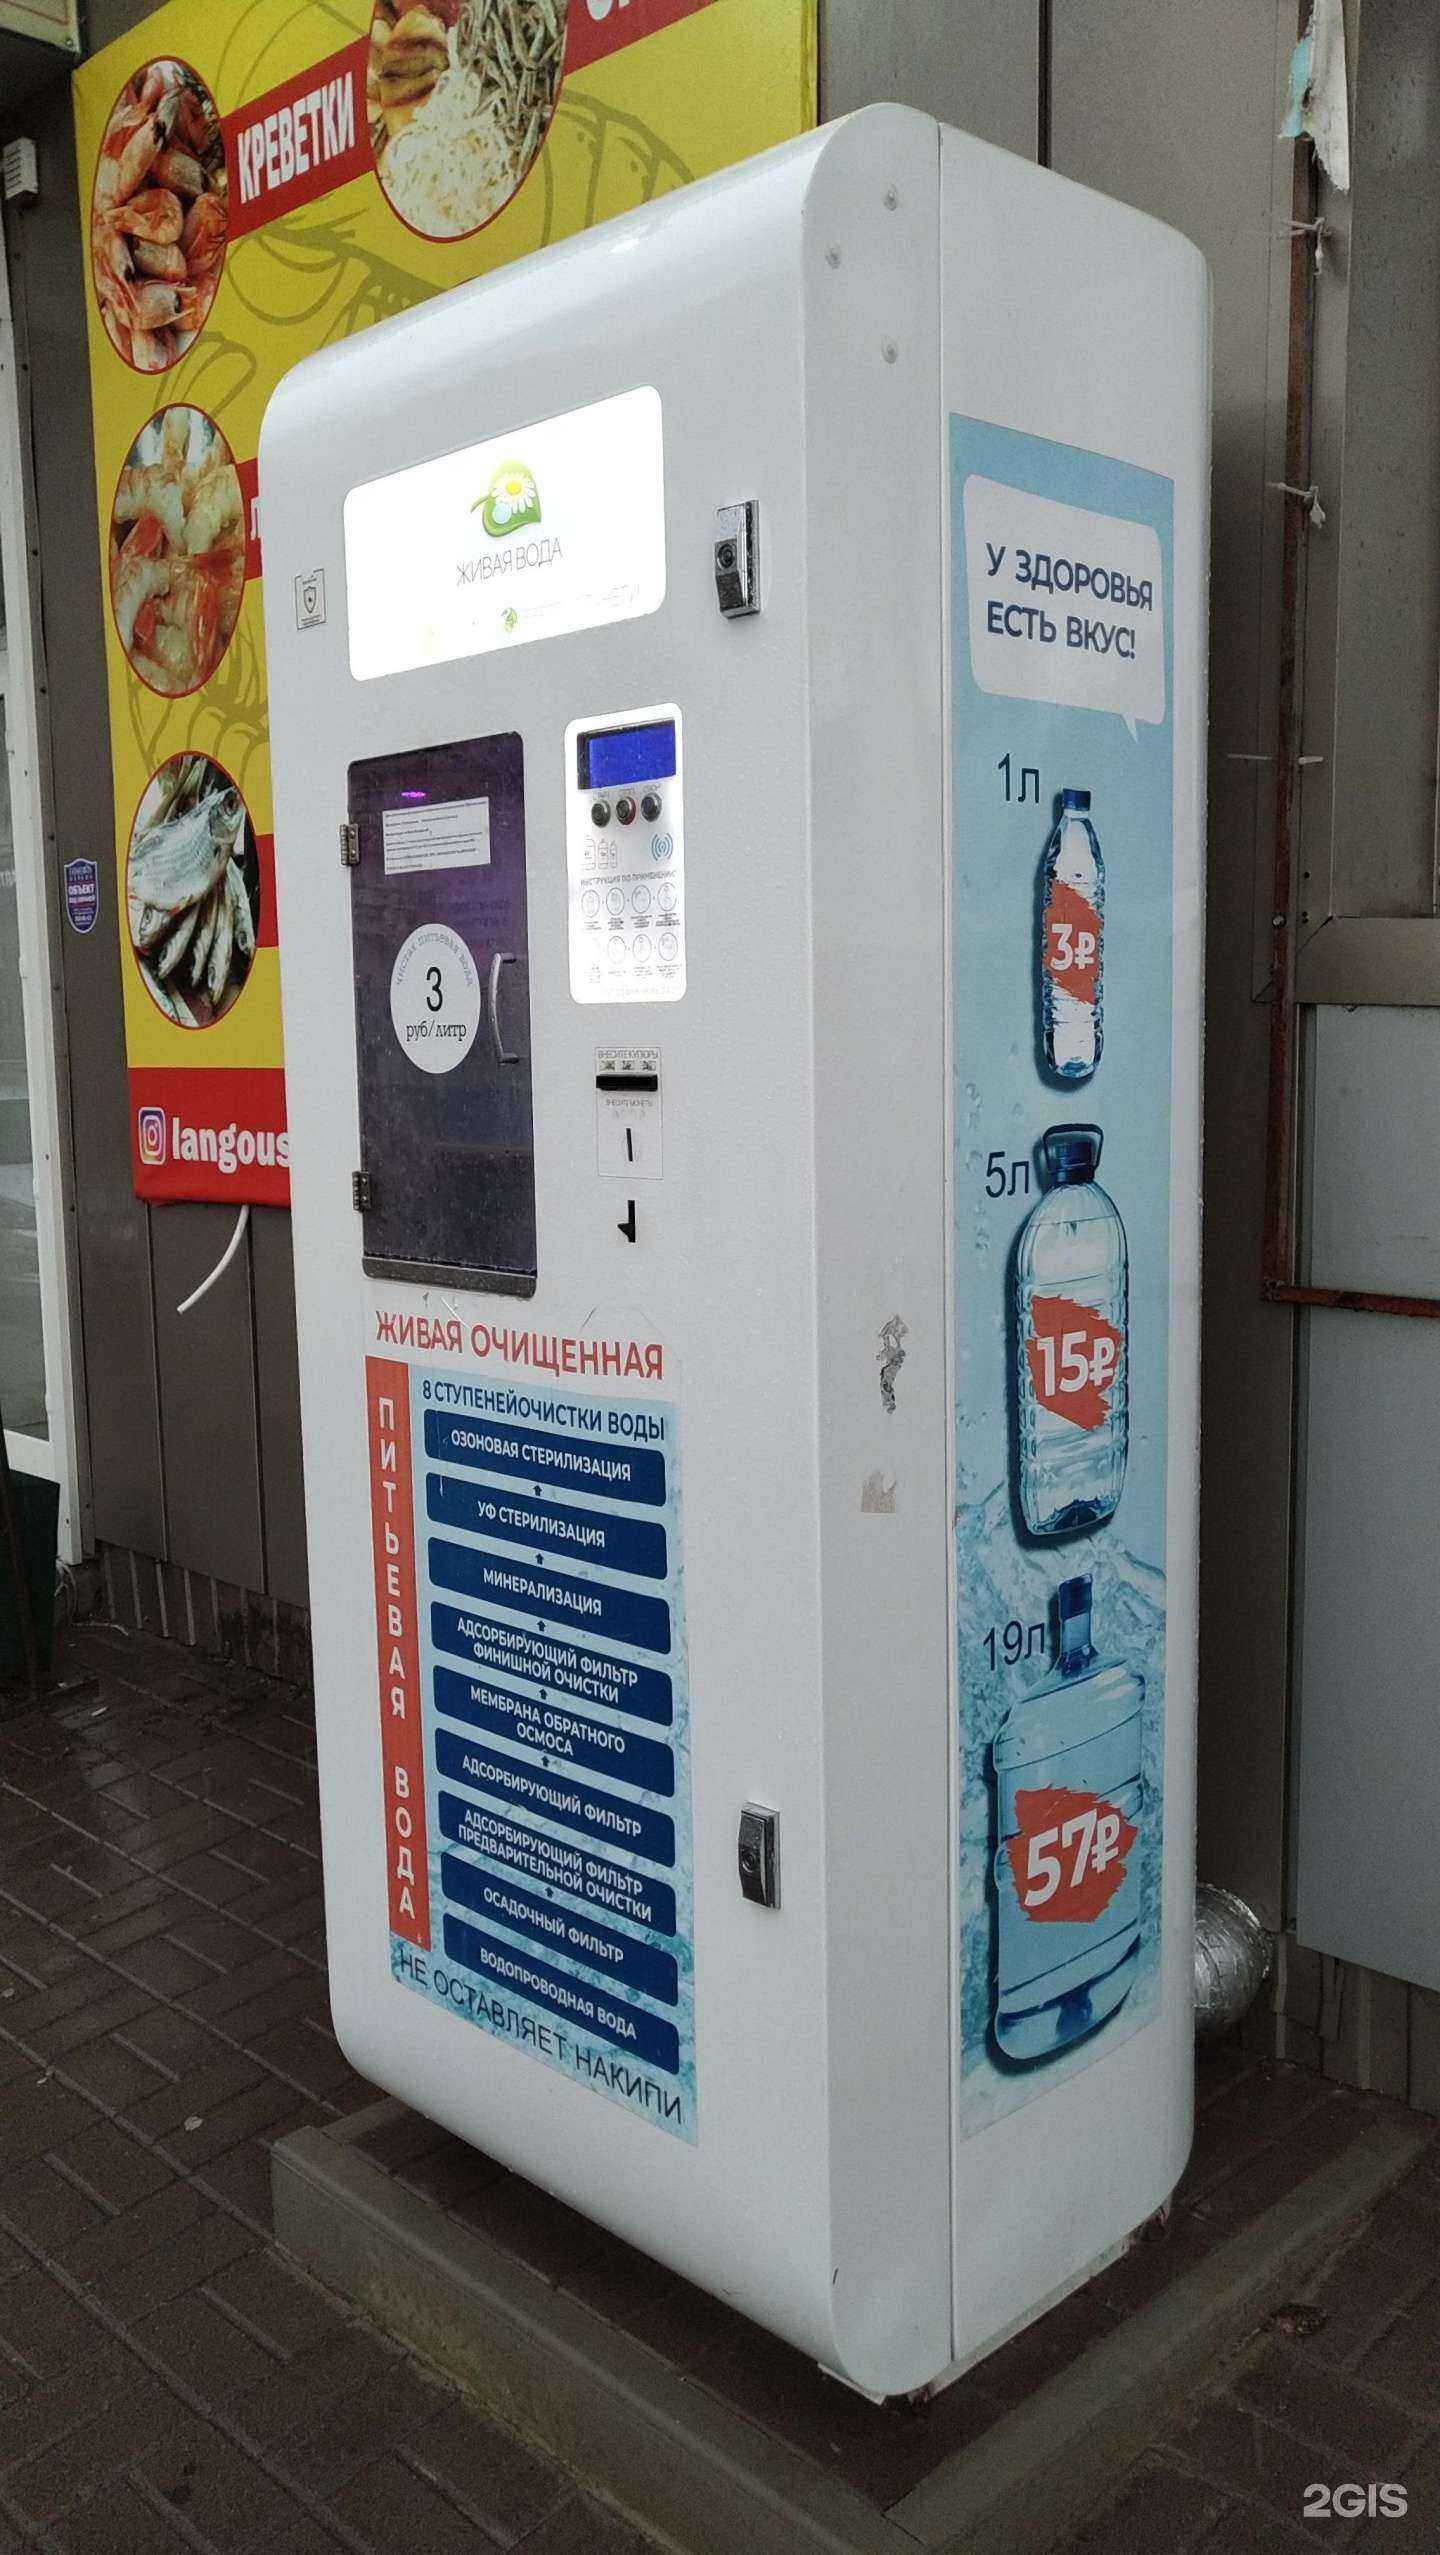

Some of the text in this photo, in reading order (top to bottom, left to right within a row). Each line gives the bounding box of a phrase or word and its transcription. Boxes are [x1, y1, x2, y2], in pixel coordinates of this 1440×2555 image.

[237, 71, 355, 204] КРЕВЕТКИ
[456, 537, 563, 586] ЖИВАЯ ВОДА
[986, 542, 1153, 611] У ЗДОРОВЬЯ
[987, 600, 1136, 660] ЕСТЬ ВКУС!
[998, 752, 1040, 804] 1л
[426, 967, 443, 1011] 3
[406, 1020, 467, 1042] руб/литр
[985, 1151, 1030, 1199] 5л
[376, 1310, 663, 1381] ЖИВАЯ ОЧИЩЕННАЯ
[422, 1380, 432, 1400] 8
[608, 1412, 664, 1442] ВОДЫ
[451, 1429, 631, 1482] ОЗОНОВАЯ СТЕРИЛИЗАЦИЯ
[477, 1500, 605, 1548] УФ СТЕРИЛИЗАЦИЯ
[378, 1396, 405, 1720] ПИТЬЕВАЯ
[483, 1567, 602, 1617] МИНЕРАЛИЗАЦИЯ
[457, 1617, 638, 1687] АДСОРБИРУЮЩИЙ ФИЛЬТР
[473, 1642, 619, 1704] ФИНИШНОЙ ОЧИСТКИ
[983, 1620, 1045, 1671] 19л
[470, 1685, 626, 1753] МЕМБРАНА ОБРАТНОГО
[516, 1722, 574, 1756] ОСМОСА
[462, 1755, 642, 1837] АДСОРБИРУЮЩИЙ ФИЛЬТР
[394, 1766, 416, 1920] ВОДА
[458, 1823, 652, 1923] ПРЕДВАРИТЕЛЬНОЙ ОЧИСТКИ
[465, 1809, 643, 1896] АДСОРБИРУЮЩИЙ ФИЛЬТР
[484, 1887, 624, 1963] ОСАДОЧНЫЙ ФИЛЬТР
[480, 1947, 637, 2041] ВОДОПРОВОДНАЯ ВОДА
[400, 1948, 682, 2125] НЕ ОСТАВЛЯЕТ НАКИПИ
